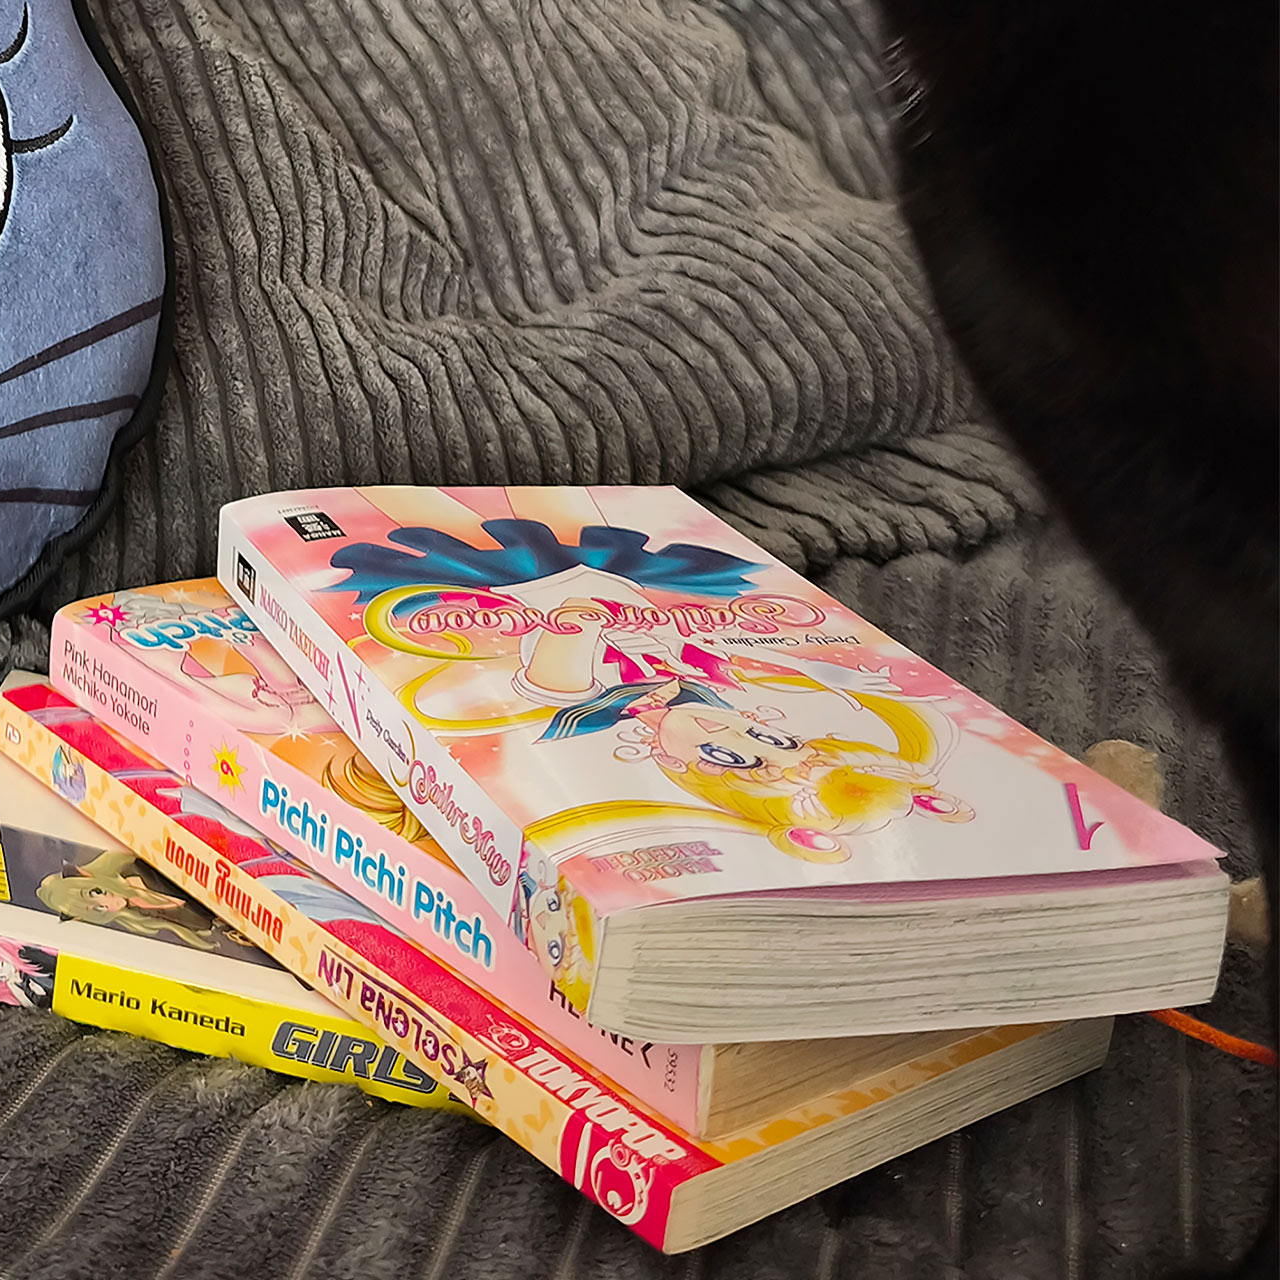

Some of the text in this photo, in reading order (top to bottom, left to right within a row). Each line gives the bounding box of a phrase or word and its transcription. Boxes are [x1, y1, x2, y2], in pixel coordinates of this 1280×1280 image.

[408, 594, 826, 636] Sailor Moon
[721, 635, 800, 647] Guardian
[62, 664, 150, 735] Michiko Yokote
[64, 640, 159, 718] Pink Hanamori
[408, 760, 469, 827] Sailor
[1064, 783, 1104, 851] 1
[261, 778, 492, 967] Pichi Pichi Pitch
[623, 857, 723, 882] NAOKO
[70, 978, 246, 1037] Mario Kaneda
[514, 1046, 687, 1161] TOKYOPOP
